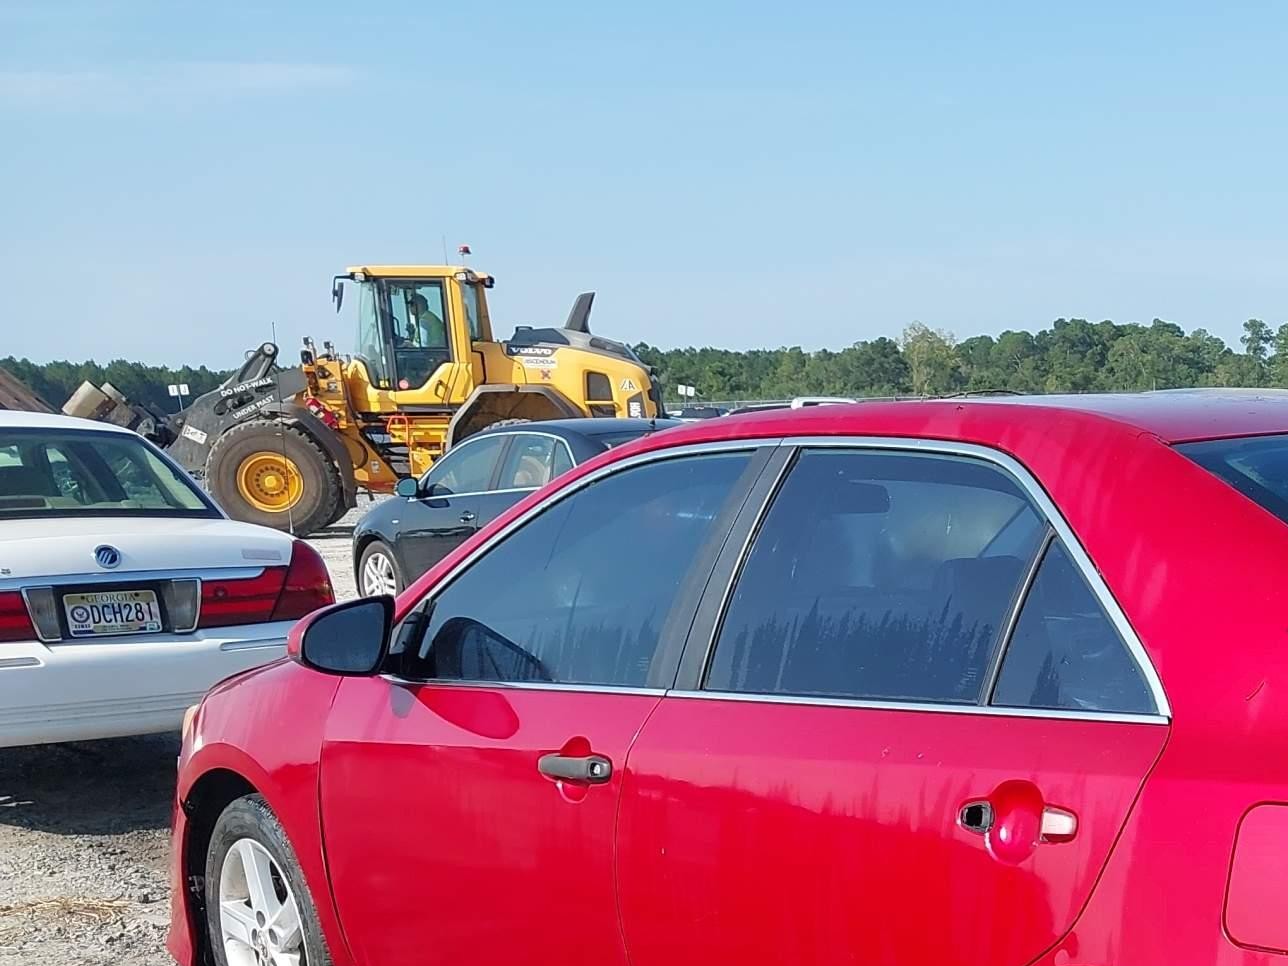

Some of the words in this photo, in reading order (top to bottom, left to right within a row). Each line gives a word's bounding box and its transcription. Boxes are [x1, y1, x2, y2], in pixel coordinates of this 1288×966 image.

[511, 347, 552, 355] VOLVO
[220, 388, 233, 397] DO
[232, 404, 257, 419] UNDER
[256, 395, 274, 408] MAST
[86, 592, 136, 603] GEORGIA
